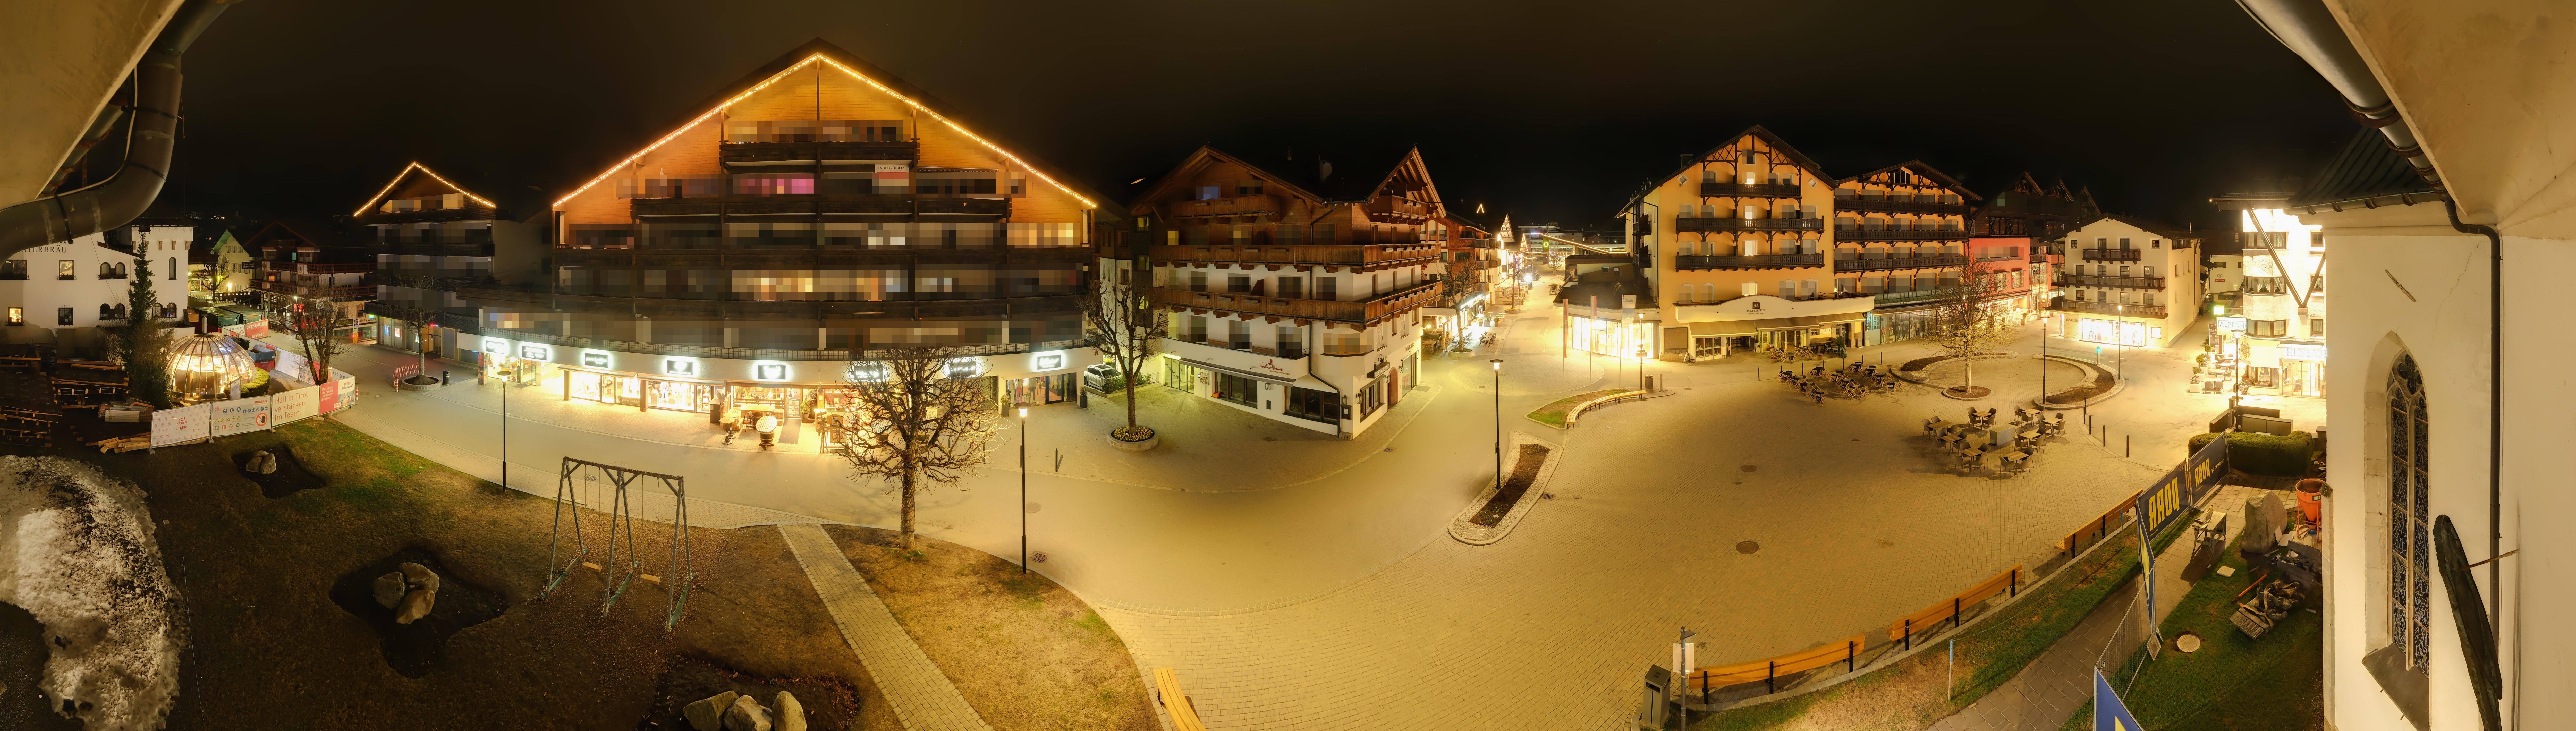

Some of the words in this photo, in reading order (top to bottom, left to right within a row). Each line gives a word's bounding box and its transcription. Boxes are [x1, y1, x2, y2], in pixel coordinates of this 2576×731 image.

[1375, 364, 1389, 377] RESTAURANT
[275, 396, 286, 404] Hall
[295, 391, 308, 399] Tirol
[275, 401, 307, 412] verstärken.
